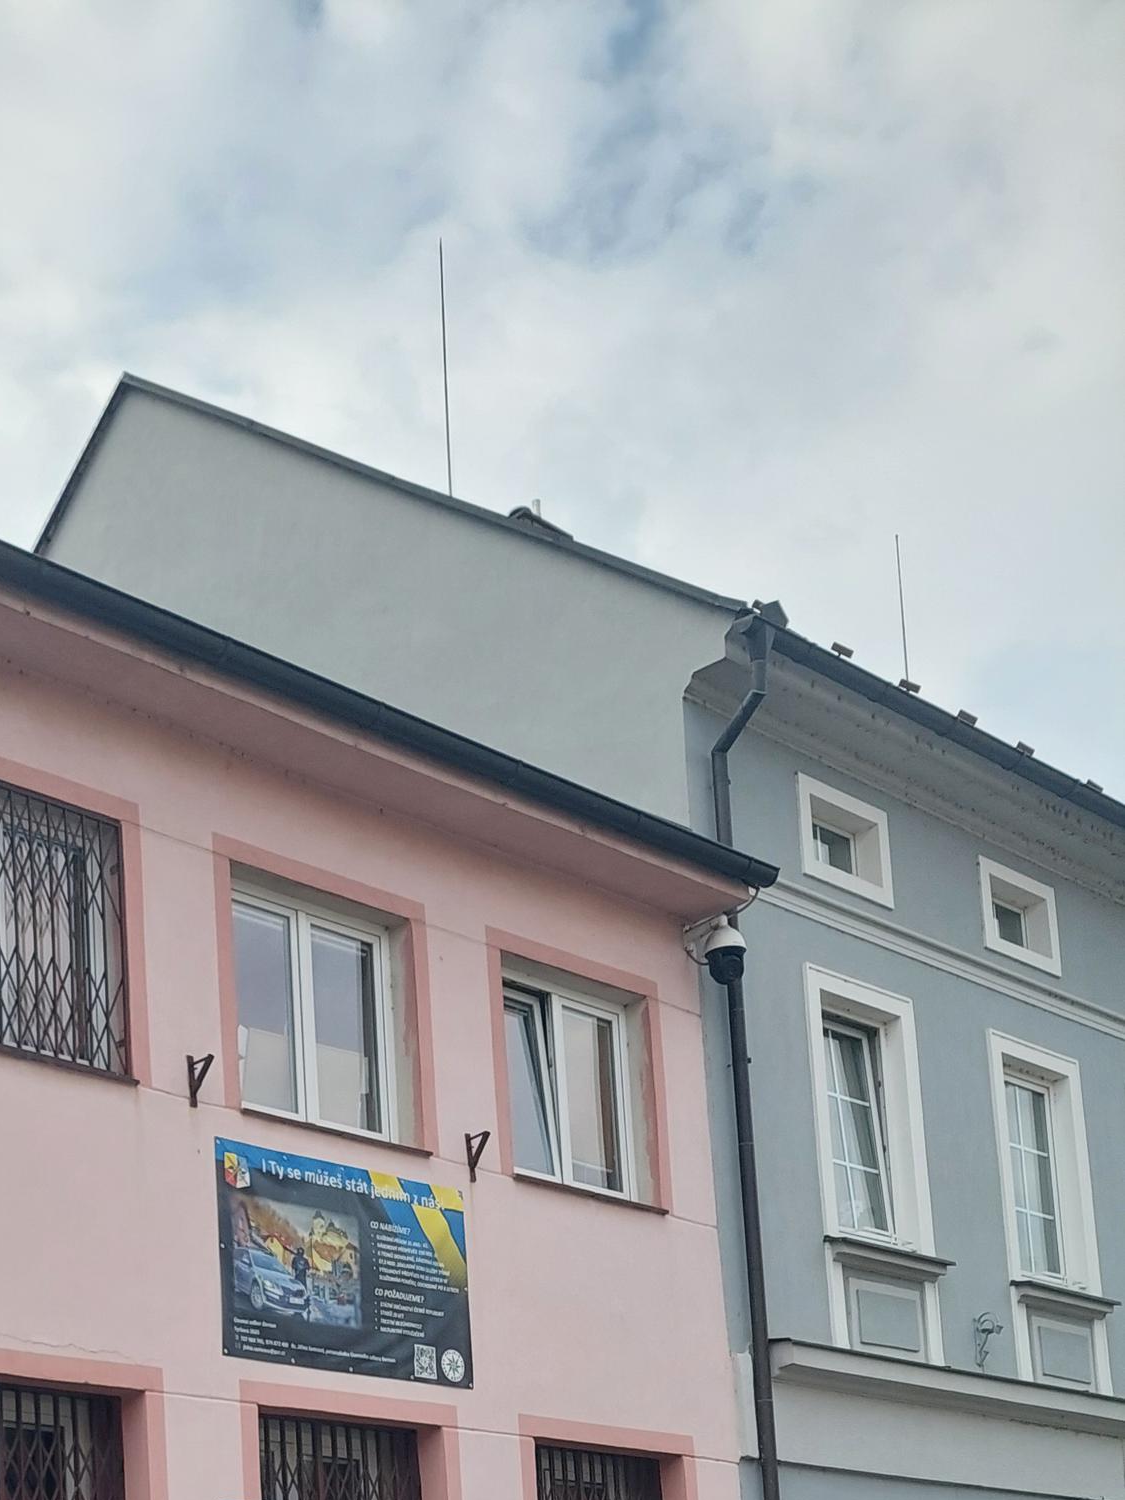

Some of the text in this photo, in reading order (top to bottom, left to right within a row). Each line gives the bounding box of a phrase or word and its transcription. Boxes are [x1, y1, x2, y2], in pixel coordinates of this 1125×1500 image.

[261, 1158, 266, 1173] I
[268, 1160, 284, 1180] Ty
[287, 1167, 302, 1180] se
[304, 1168, 343, 1189] můžeš
[345, 1178, 369, 1195] stát
[413, 1194, 418, 1205] z
[375, 1287, 383, 1296] CO
